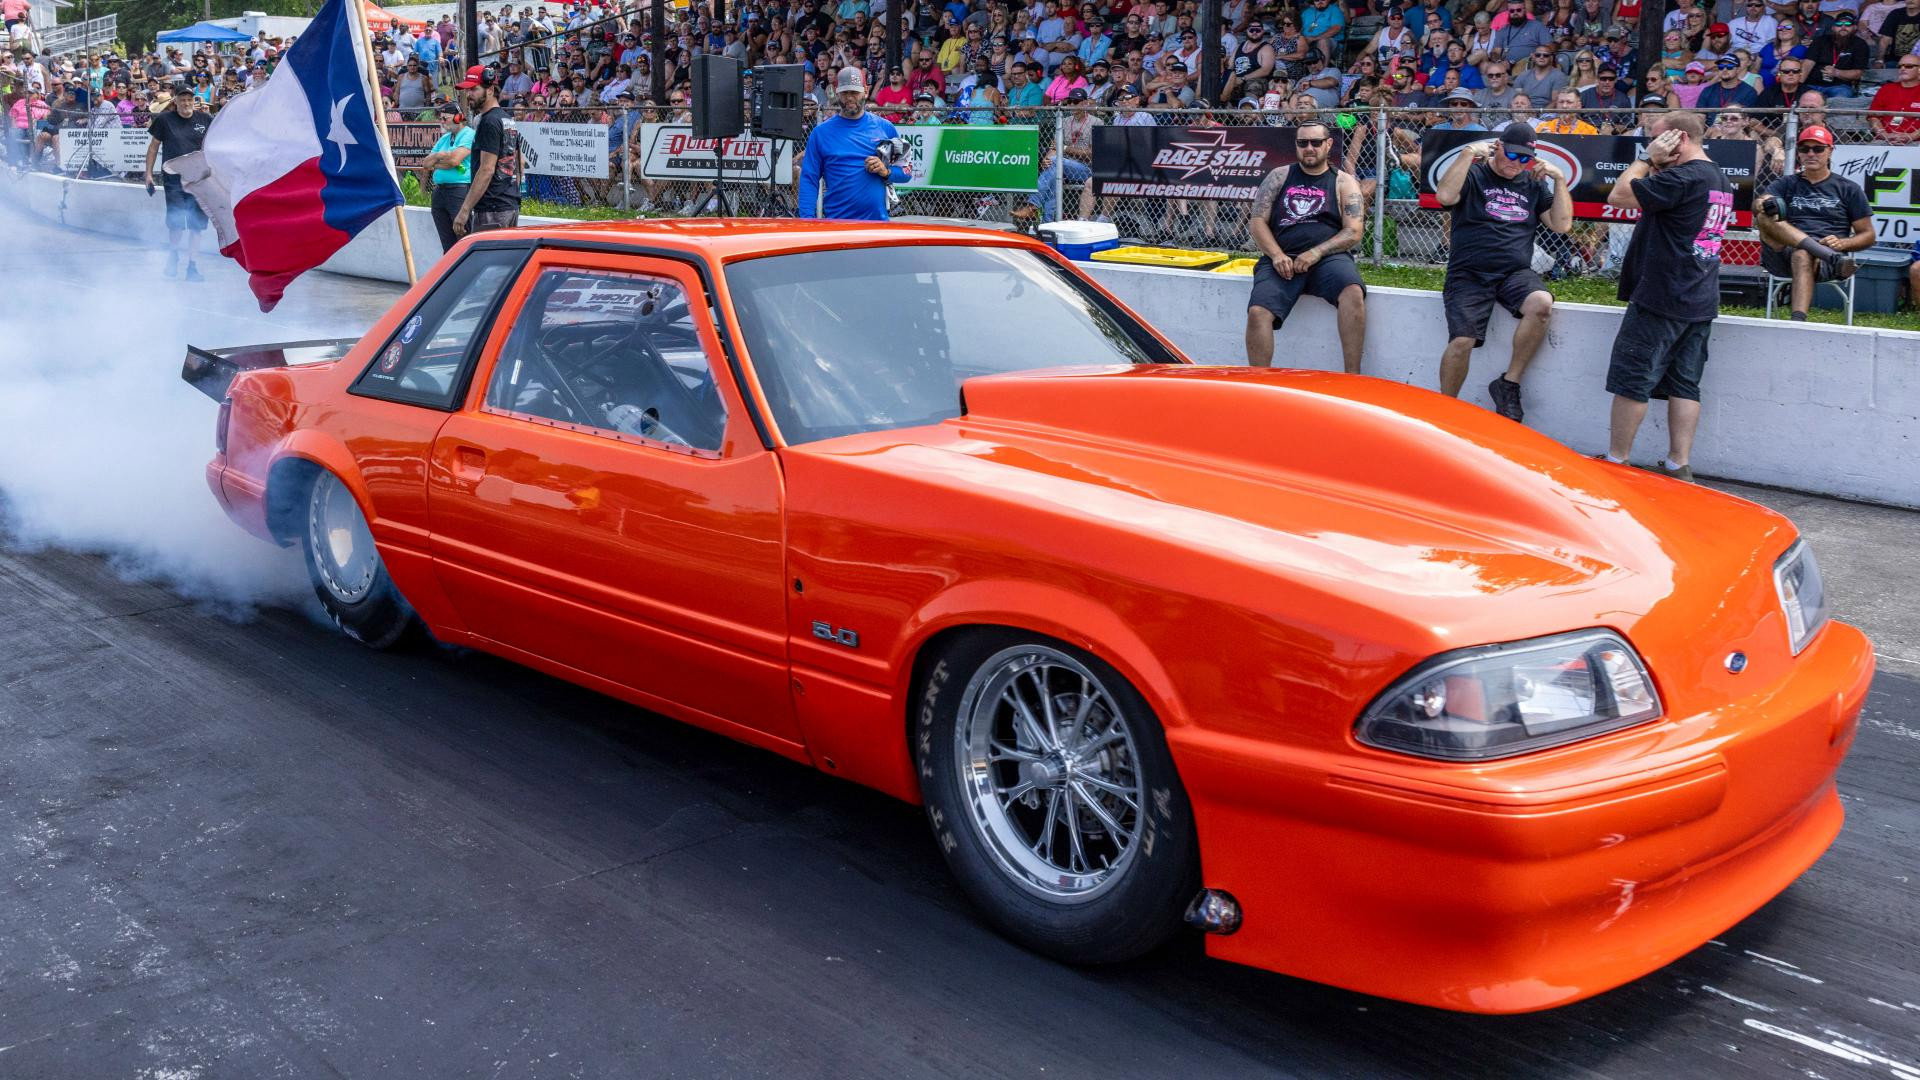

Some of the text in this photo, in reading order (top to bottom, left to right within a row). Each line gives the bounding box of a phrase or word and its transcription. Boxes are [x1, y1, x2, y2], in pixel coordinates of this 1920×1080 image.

[551, 128, 570, 136] Veterans
[571, 128, 593, 137] Memorial
[550, 138, 566, 147] Phone:
[584, 154, 597, 163] Road
[945, 150, 1031, 165] VisitBGKY.com
[1153, 149, 1267, 167] RACE STAR
[551, 163, 566, 172] Phone:
[1839, 150, 1890, 177] TEAM
[1211, 168, 1261, 177] WHEELS
[812, 621, 858, 647] 5.0
